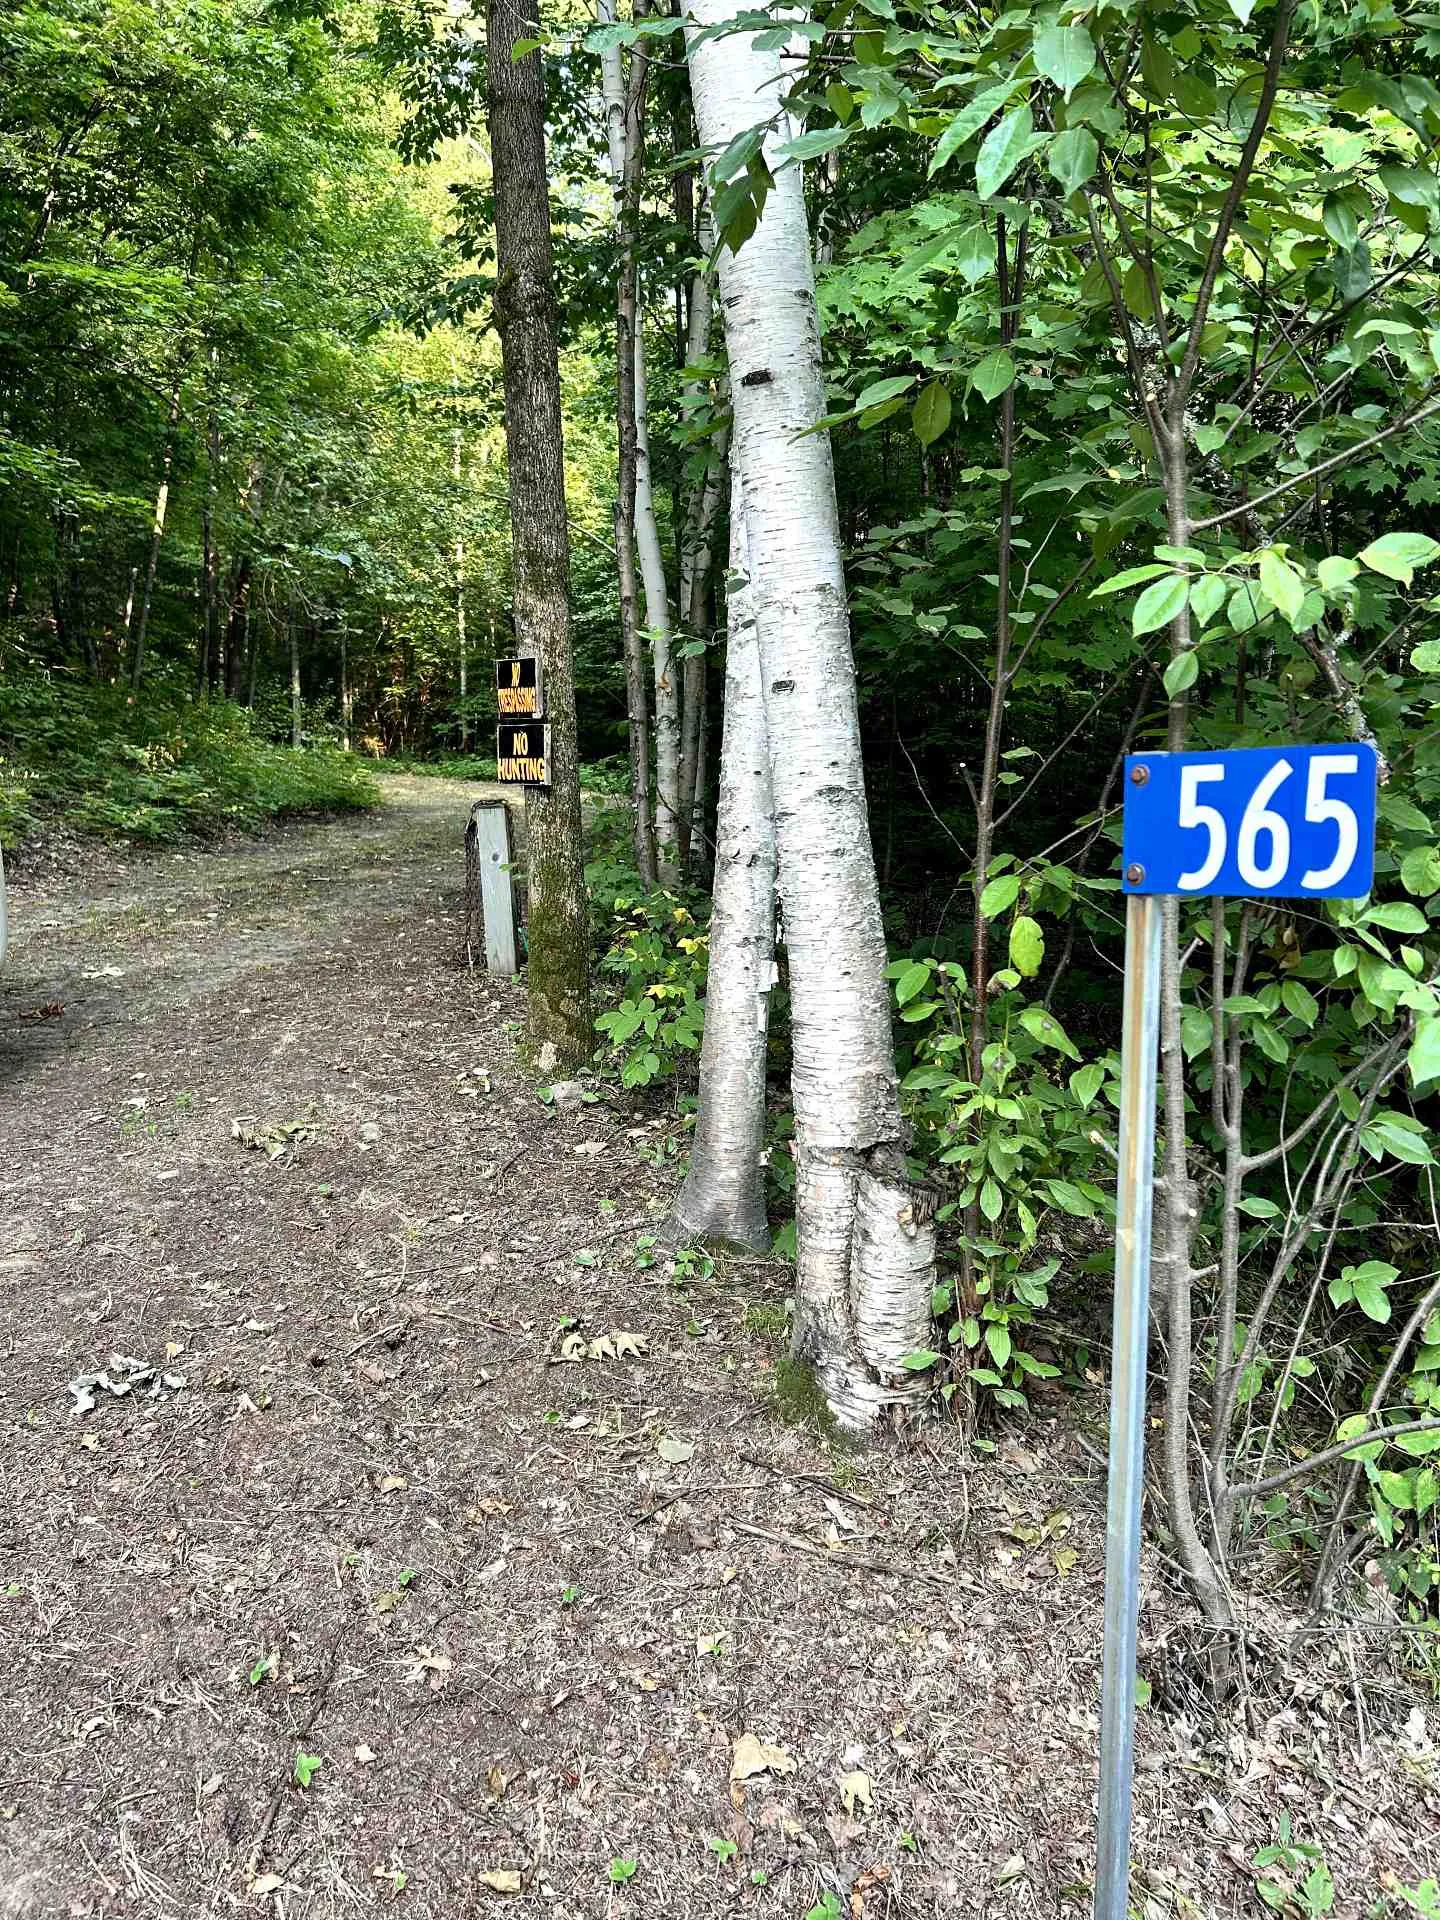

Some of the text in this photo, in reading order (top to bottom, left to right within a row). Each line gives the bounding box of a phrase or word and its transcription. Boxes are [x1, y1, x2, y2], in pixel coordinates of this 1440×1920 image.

[511, 662, 520, 687] NO
[513, 733, 528, 755] NO
[498, 758, 545, 780] HUNTING
[1177, 755, 1359, 889] 565
